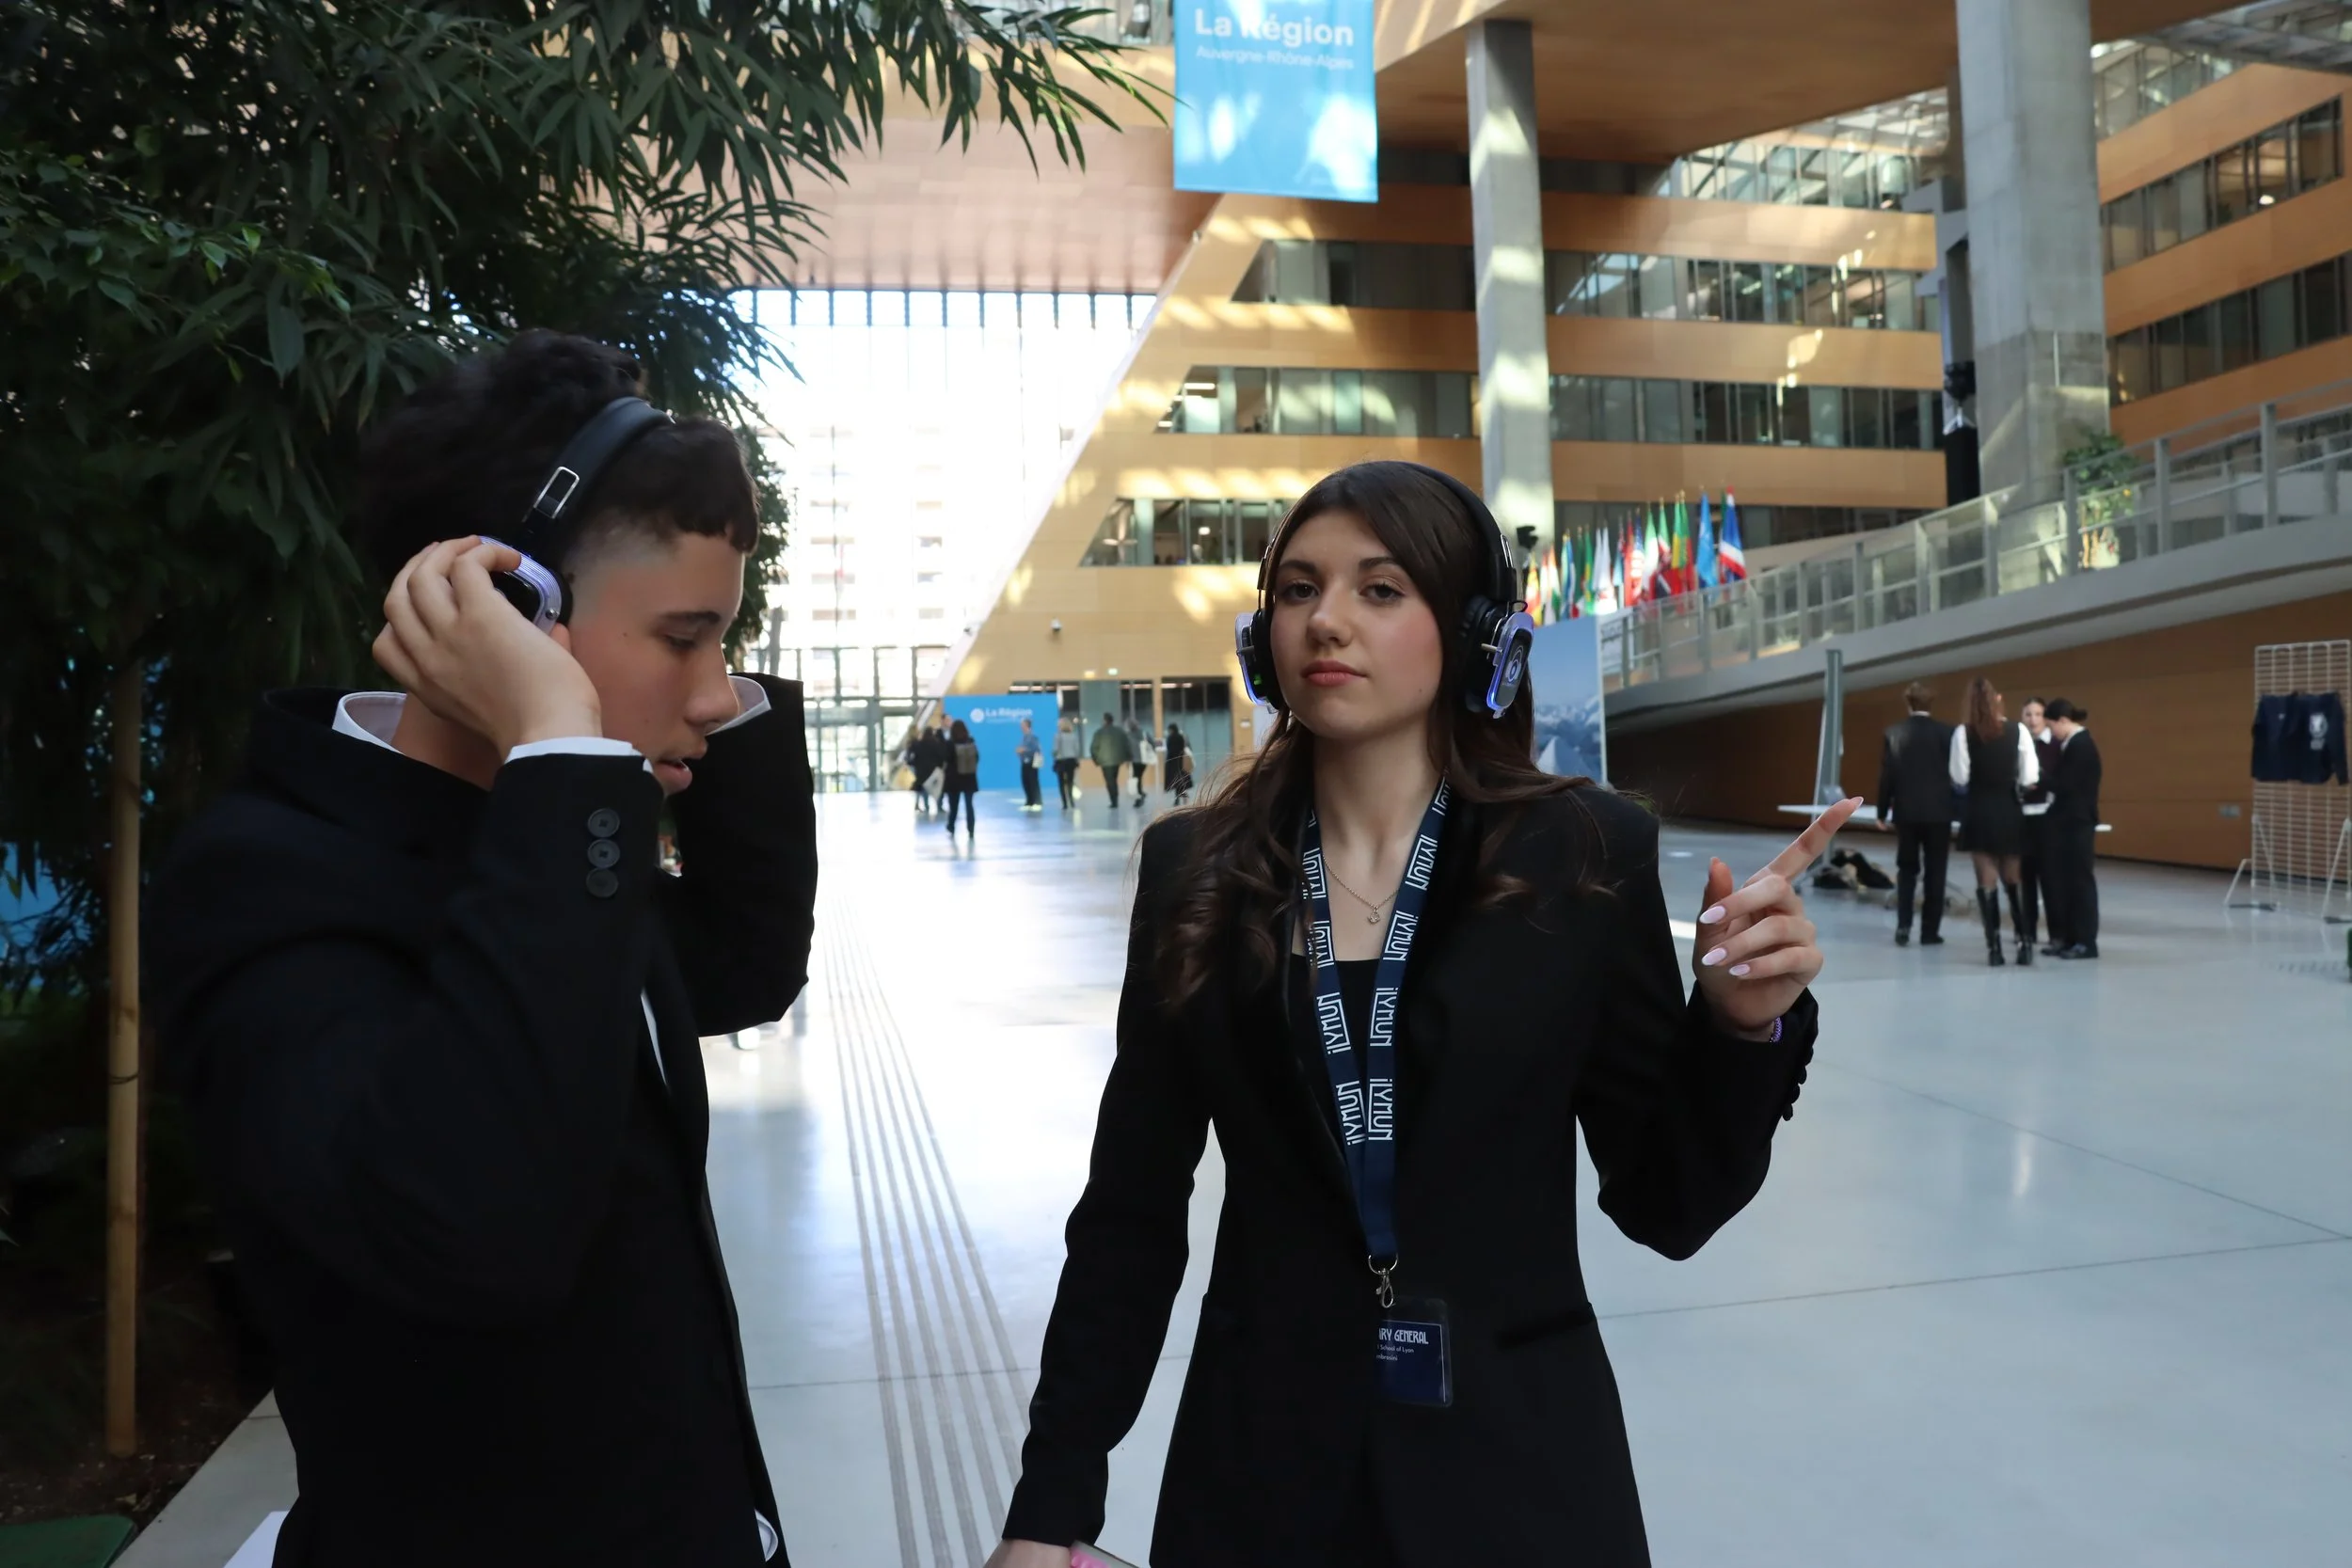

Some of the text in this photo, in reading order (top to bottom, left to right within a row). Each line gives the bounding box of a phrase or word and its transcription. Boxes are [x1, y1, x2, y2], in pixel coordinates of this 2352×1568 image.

[1194, 8, 1354, 48] La Région
[1196, 45, 1355, 71] Auvergne-Rhône-Alpes
[1394, 1329, 1429, 1345] GENERAL
[1402, 1346, 1415, 1354] Lyon
